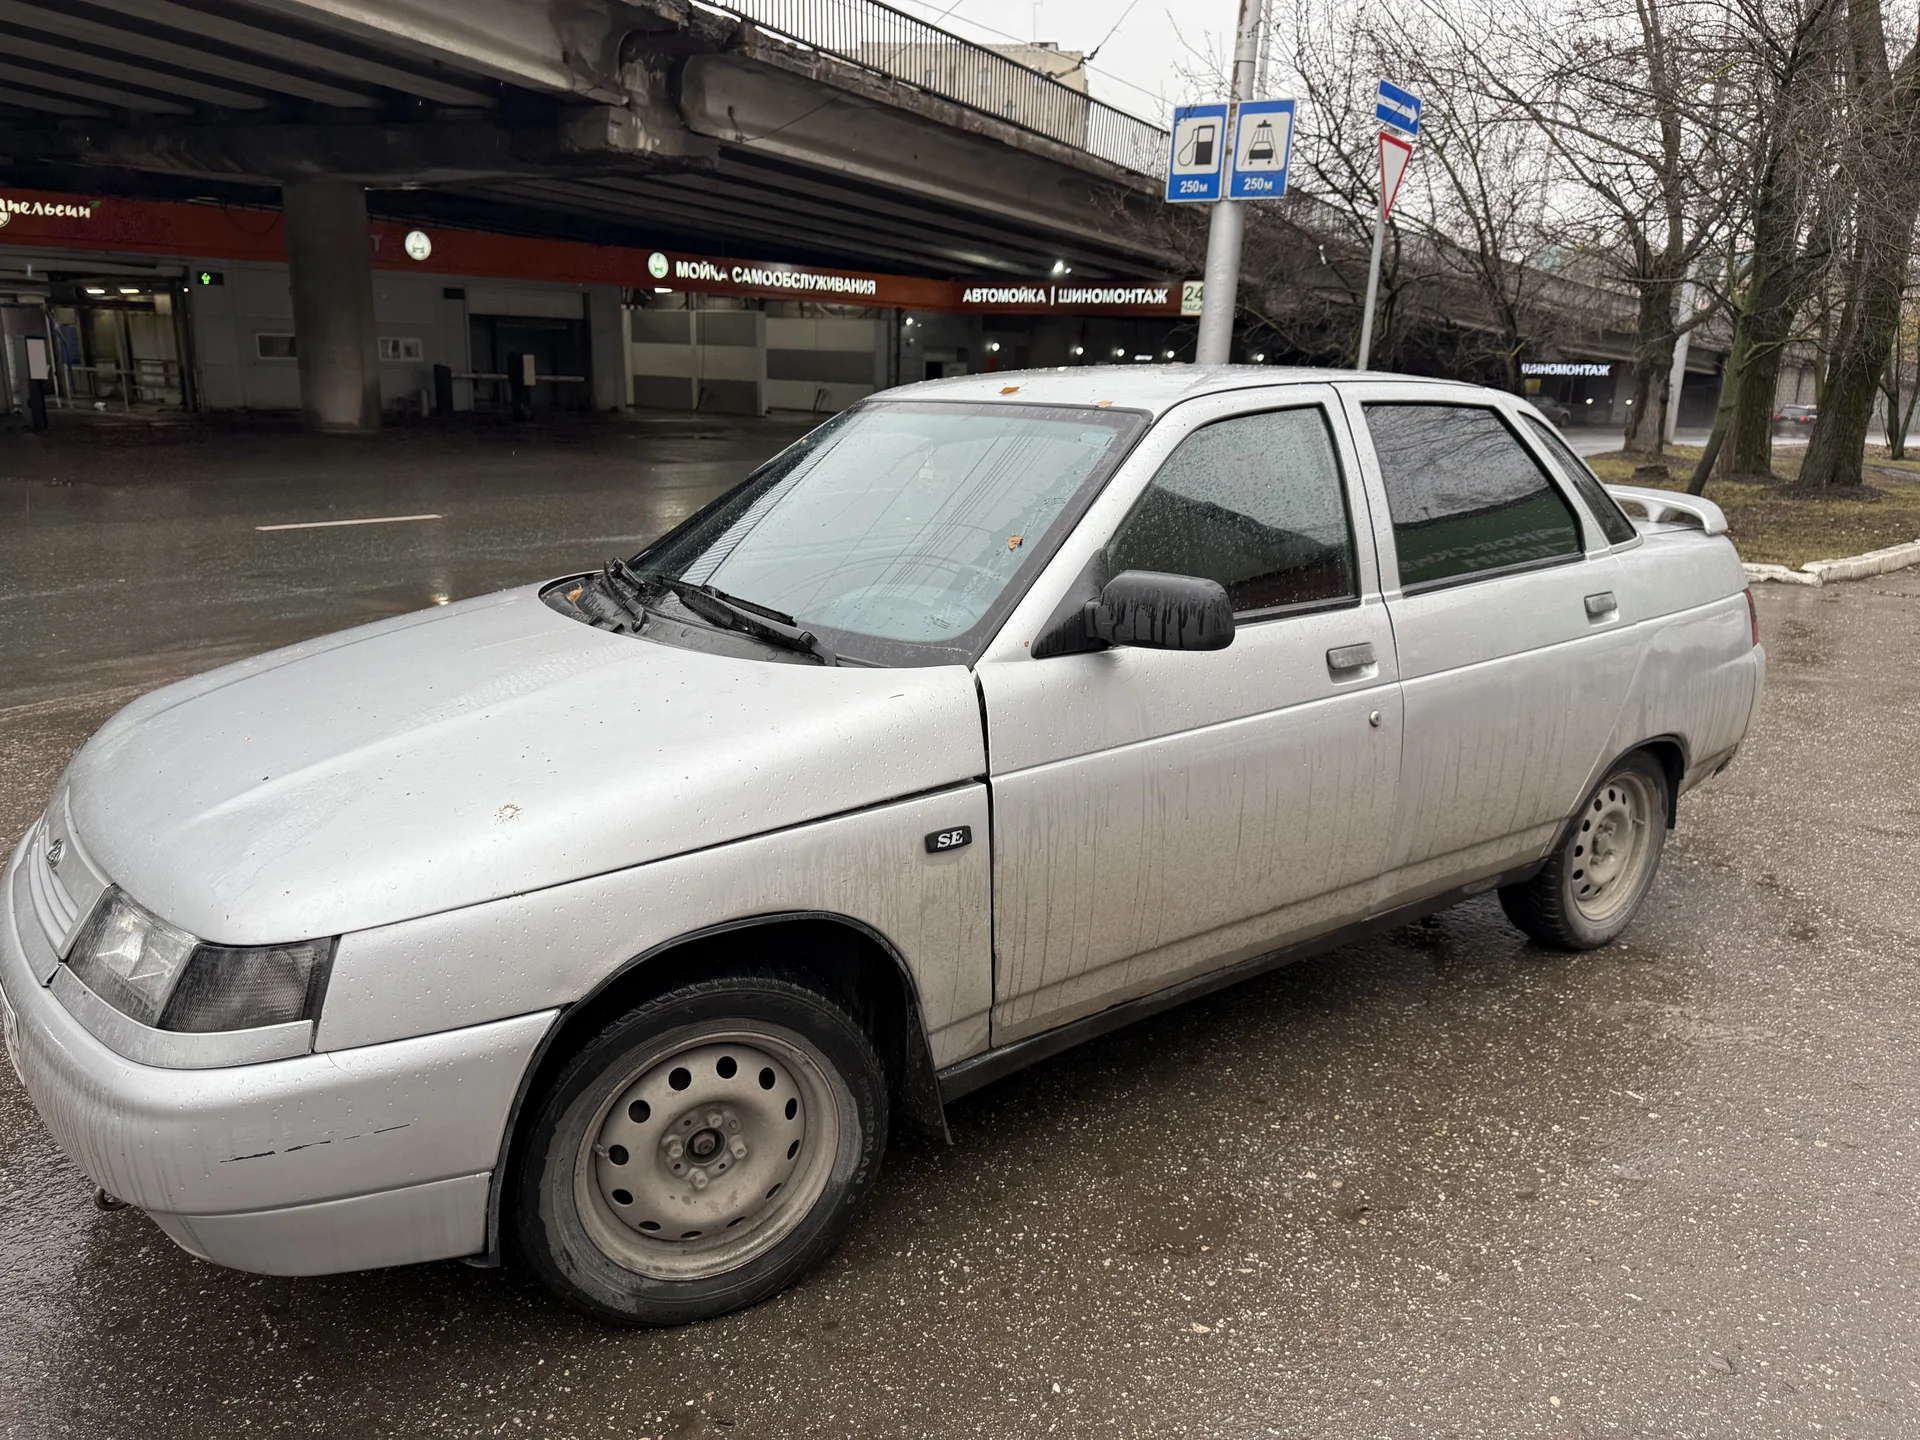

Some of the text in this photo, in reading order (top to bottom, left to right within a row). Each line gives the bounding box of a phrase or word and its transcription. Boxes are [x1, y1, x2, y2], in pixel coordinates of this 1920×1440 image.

[1180, 179, 1208, 194] 250м
[1243, 177, 1273, 191] 250м
[675, 260, 877, 295] МОЙКА САМООБСЛУЖИВАНИЯ
[962, 285, 1169, 305] АВТОМОЙКА ШИНОМОНТАЖ
[1183, 285, 1204, 302] 24
[936, 829, 963, 849] SE
[855, 1076, 875, 1185] NORDMAN
